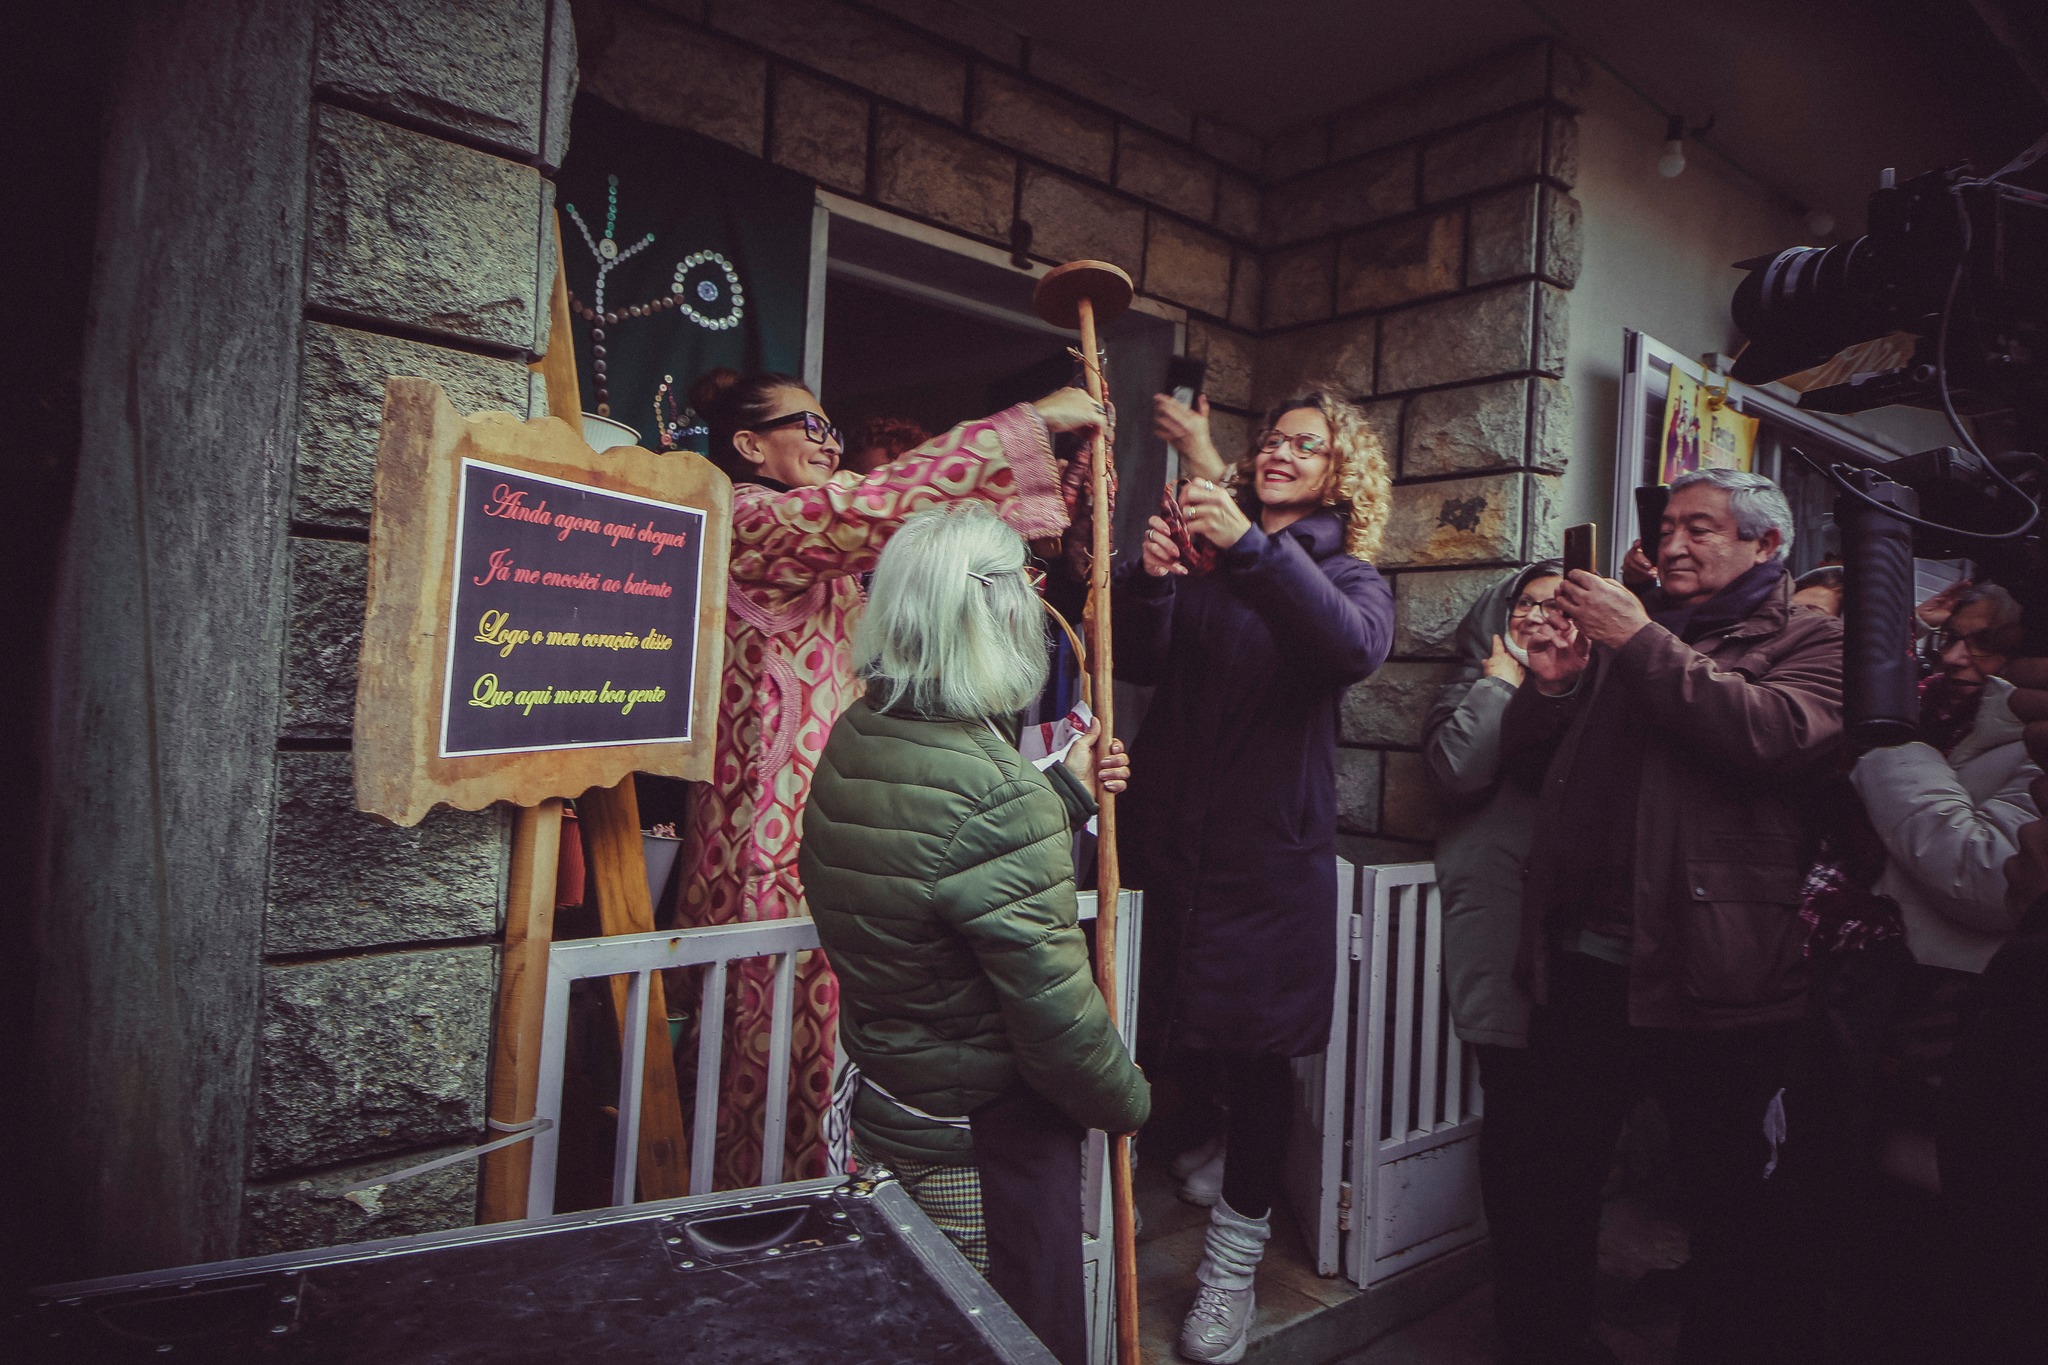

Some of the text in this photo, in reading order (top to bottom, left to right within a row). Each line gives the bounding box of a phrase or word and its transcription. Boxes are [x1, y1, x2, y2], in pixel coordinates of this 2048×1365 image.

[484, 484, 686, 556] Ainda agora aqui cheguei
[474, 548, 673, 598] Já me encostei ao batente
[474, 609, 673, 658] Logo o meu coração disse
[468, 672, 666, 716] Que aqui mora boa gente
